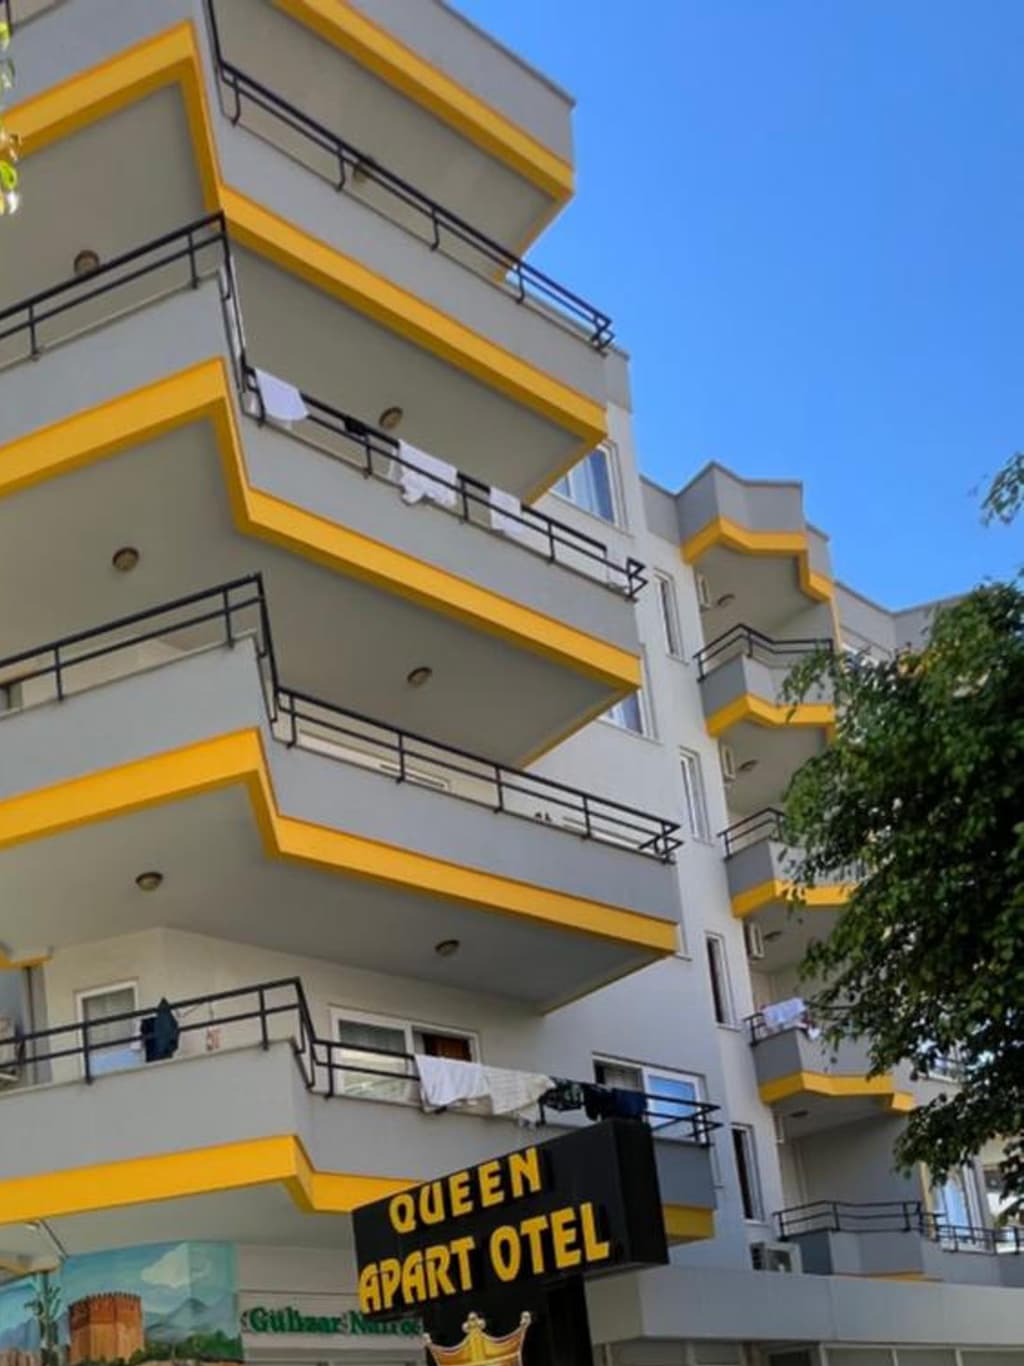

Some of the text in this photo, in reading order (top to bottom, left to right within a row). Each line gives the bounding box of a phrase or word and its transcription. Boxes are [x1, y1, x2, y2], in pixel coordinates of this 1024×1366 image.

[389, 1147, 542, 1234] QUEEN
[358, 1202, 610, 1315] APART OTEL
